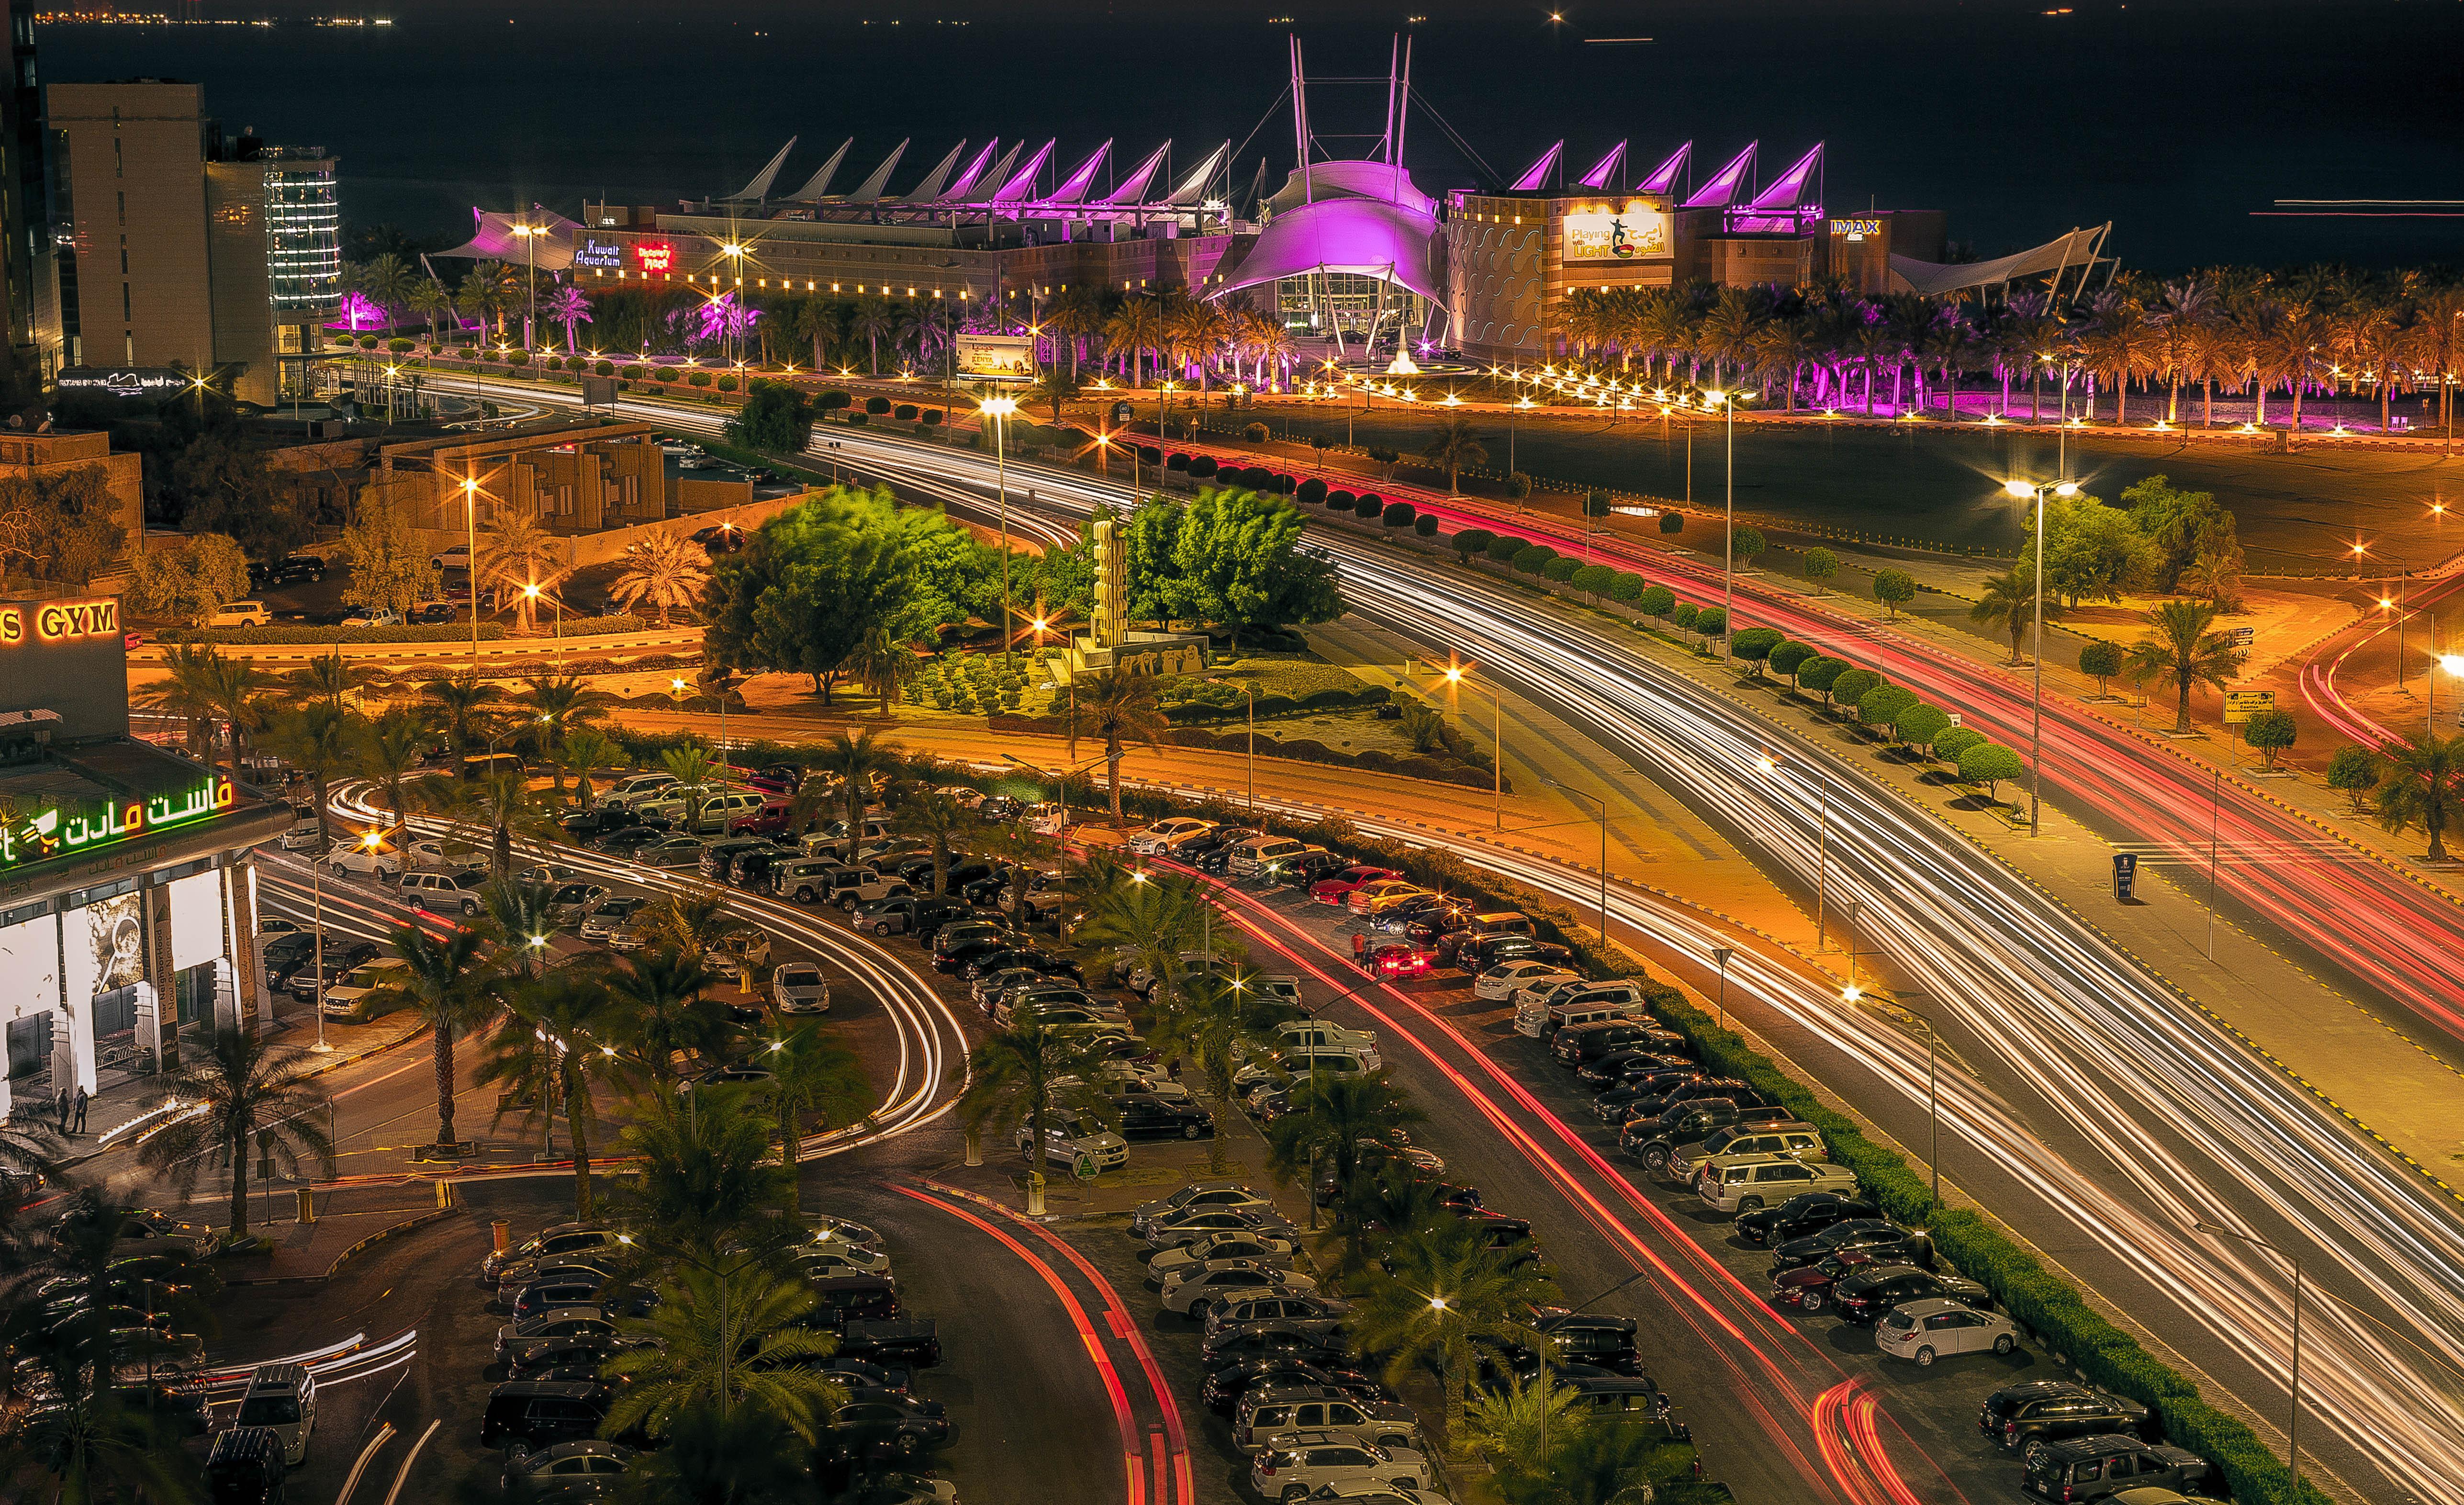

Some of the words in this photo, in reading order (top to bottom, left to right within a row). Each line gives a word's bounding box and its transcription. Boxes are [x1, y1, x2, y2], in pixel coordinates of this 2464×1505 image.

[1572, 229, 1610, 240] Playing
[1831, 220, 1880, 234] IMAX
[588, 239, 620, 256] Kuwait
[638, 244, 671, 259] Discovery
[1574, 245, 1610, 257] LIGHT
[1635, 241, 1665, 257] الضوء
[576, 250, 620, 266] Aquarium
[644, 258, 668, 270] Place
[40, 603, 117, 638] GYM
[147, 775, 233, 825] فاست
[65, 801, 141, 845] مارت
[168, 974, 173, 983] or
